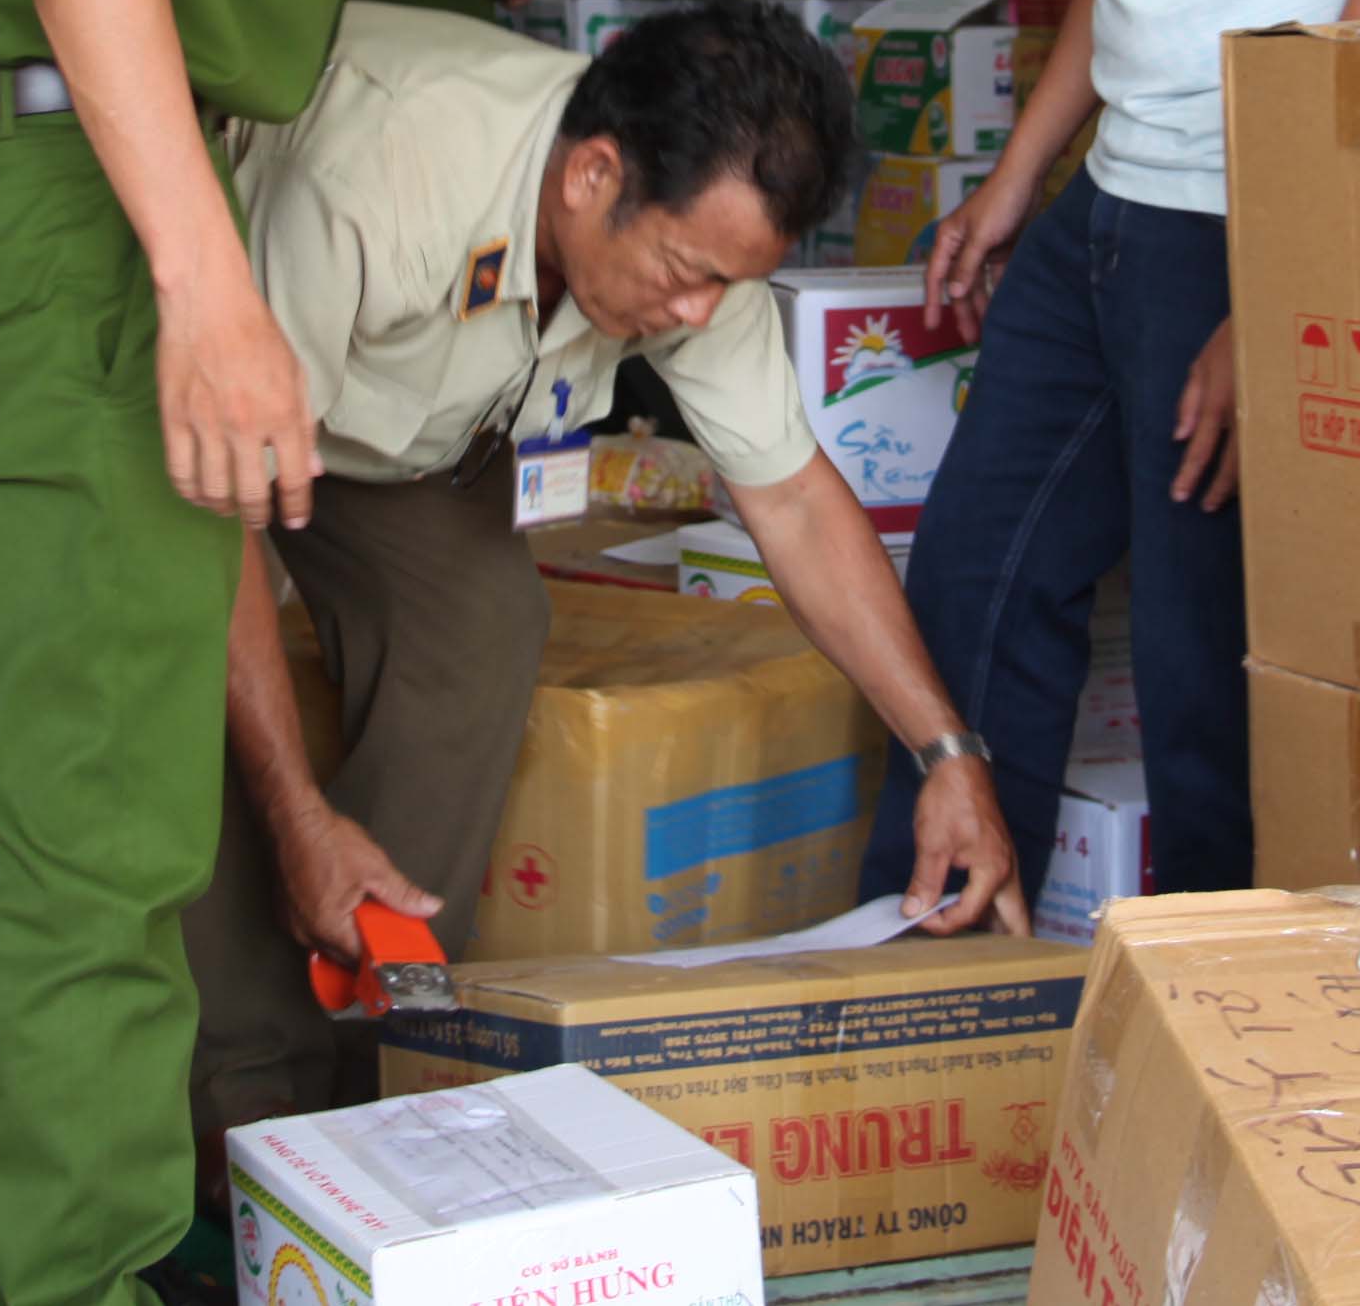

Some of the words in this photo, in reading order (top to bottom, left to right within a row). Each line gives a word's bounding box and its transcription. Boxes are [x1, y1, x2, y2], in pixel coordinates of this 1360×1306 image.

[1304, 411, 1320, 437] 12
[1322, 410, 1345, 441] HỘP
[1076, 836, 1089, 858] 4
[769, 1098, 975, 1186] TRUNG
[1062, 1130, 1085, 1190] HTX
[792, 1215, 865, 1246] TRÁCH
[875, 1211, 901, 1235] TY
[908, 1202, 967, 1234] CÔNG
[575, 1248, 619, 1268] BÁNH
[570, 1260, 675, 1306] HƯNG
